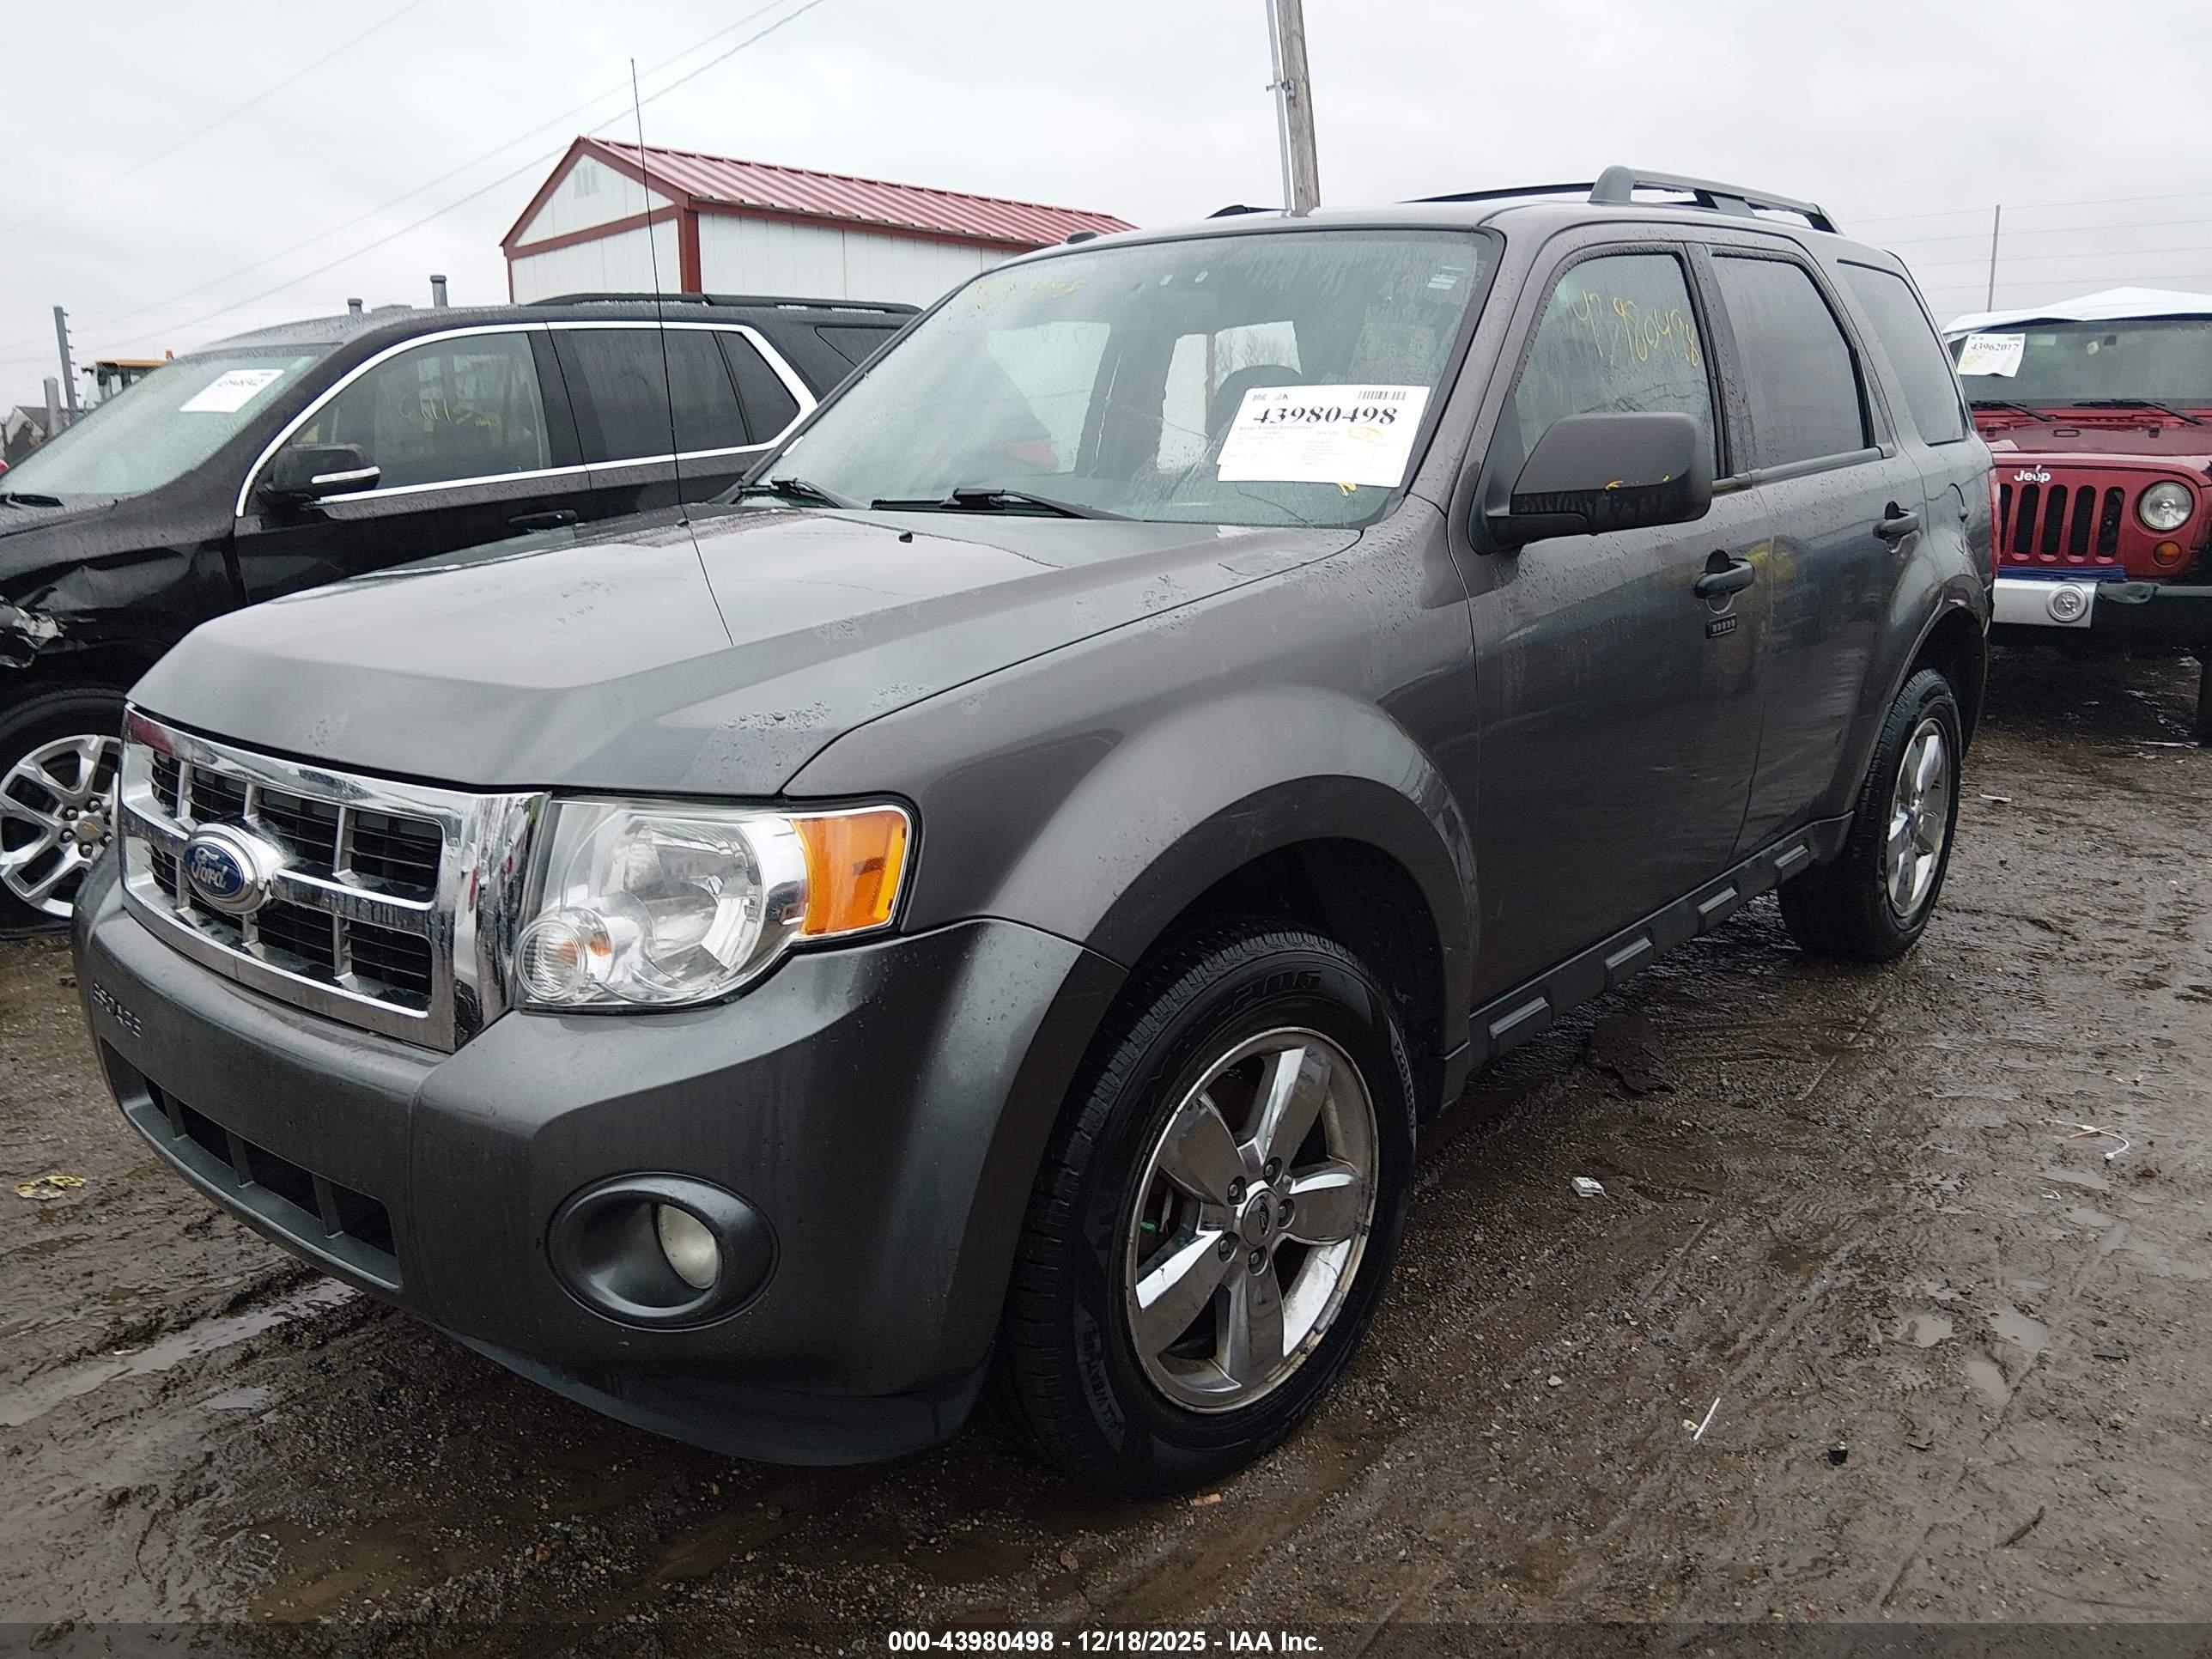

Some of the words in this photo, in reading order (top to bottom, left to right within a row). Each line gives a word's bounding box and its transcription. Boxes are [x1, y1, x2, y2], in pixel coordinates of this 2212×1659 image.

[1253, 406, 1398, 425] 43980498
[2014, 469, 2051, 483] Jeep
[191, 847, 229, 889] Ford
